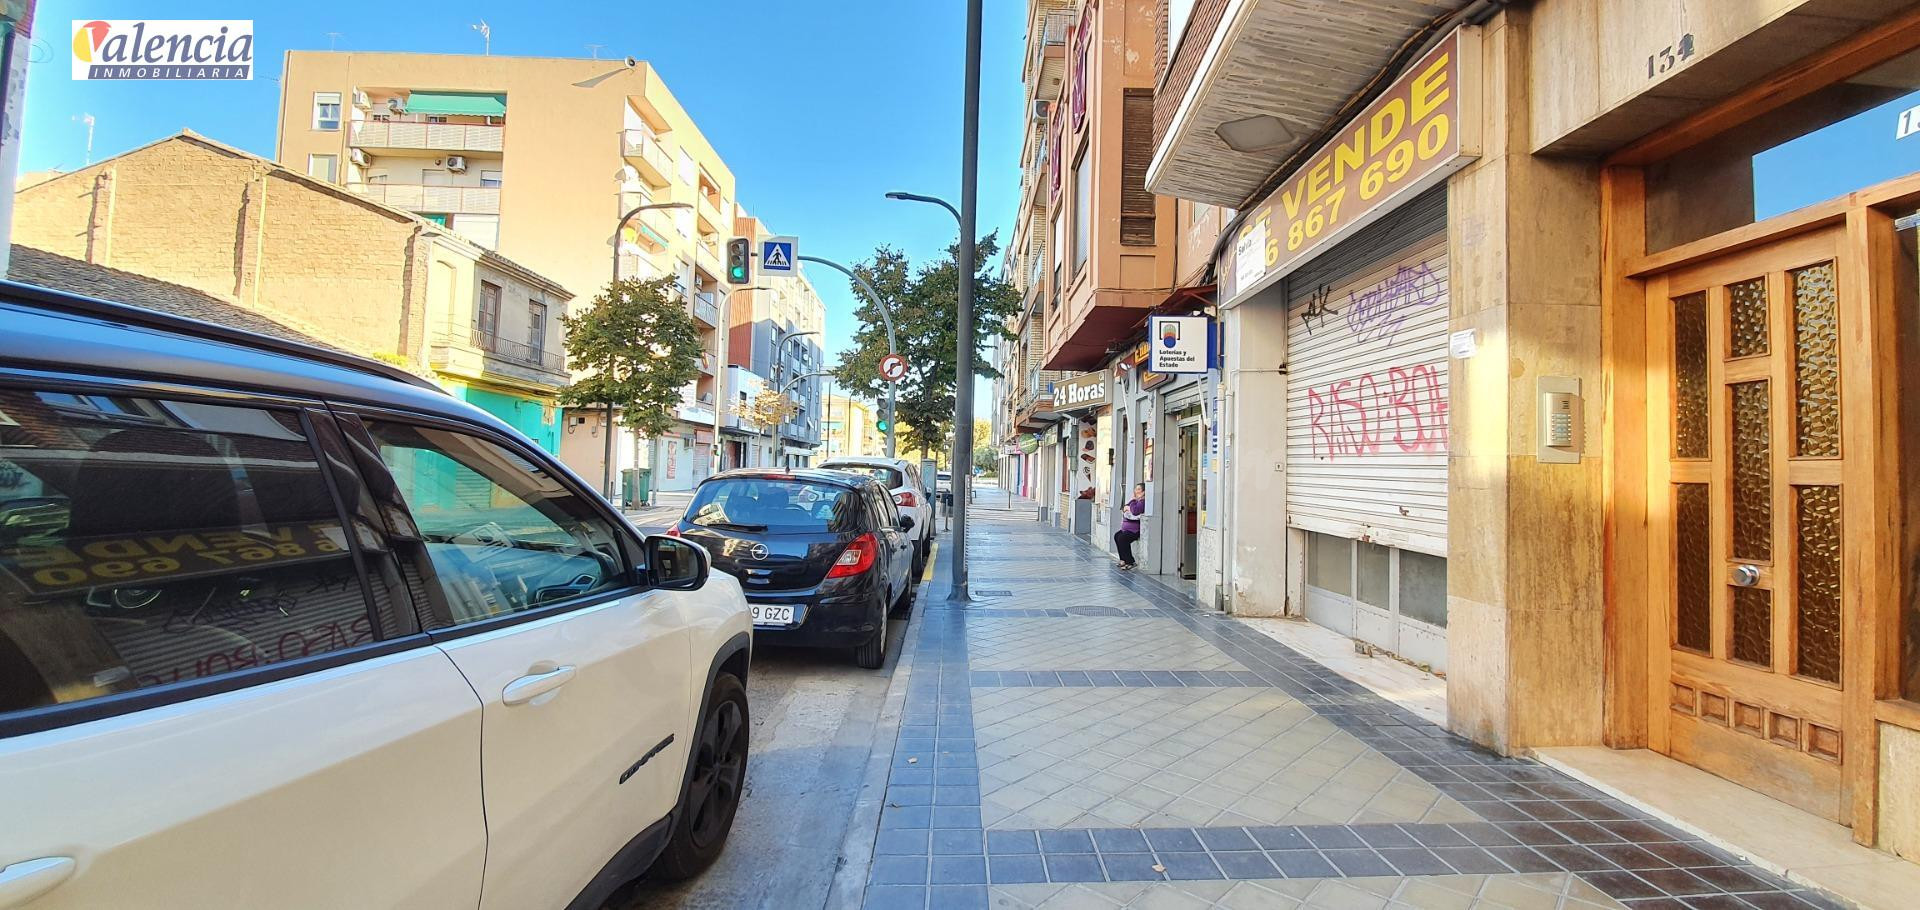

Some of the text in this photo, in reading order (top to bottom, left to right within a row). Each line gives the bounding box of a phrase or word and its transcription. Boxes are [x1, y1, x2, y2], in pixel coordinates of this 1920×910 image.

[1904, 110, 1920, 134] 1
[1281, 52, 1449, 220] VENDE
[1288, 187, 1345, 251] 867
[1360, 114, 1449, 200] 690
[1054, 383, 1104, 406] 24 Horas
[765, 608, 789, 620] GZC
